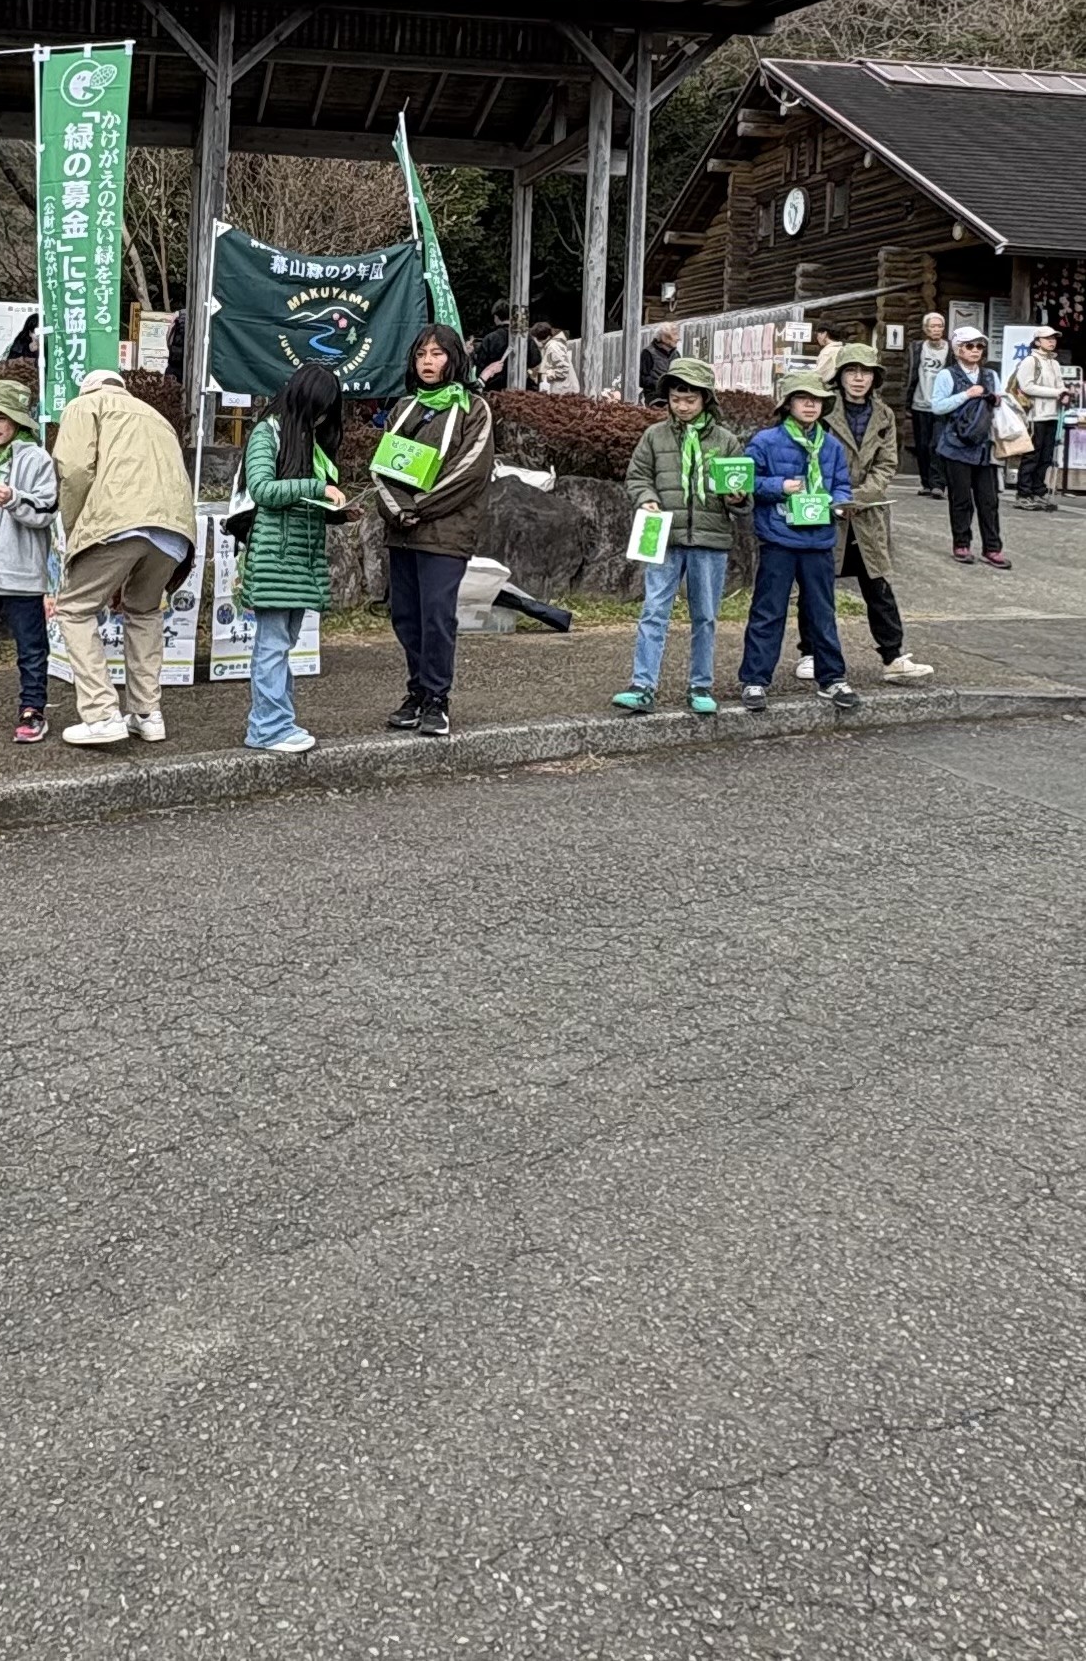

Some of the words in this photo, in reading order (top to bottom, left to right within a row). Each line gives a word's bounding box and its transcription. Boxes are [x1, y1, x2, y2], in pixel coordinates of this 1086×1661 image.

[93, 110, 121, 333] かけがえのない緑を守る。
[270, 255, 387, 281] 幕山緑の少年団
[286, 286, 371, 312] MAKUYAMA
[343, 337, 373, 375] FRIENDS
